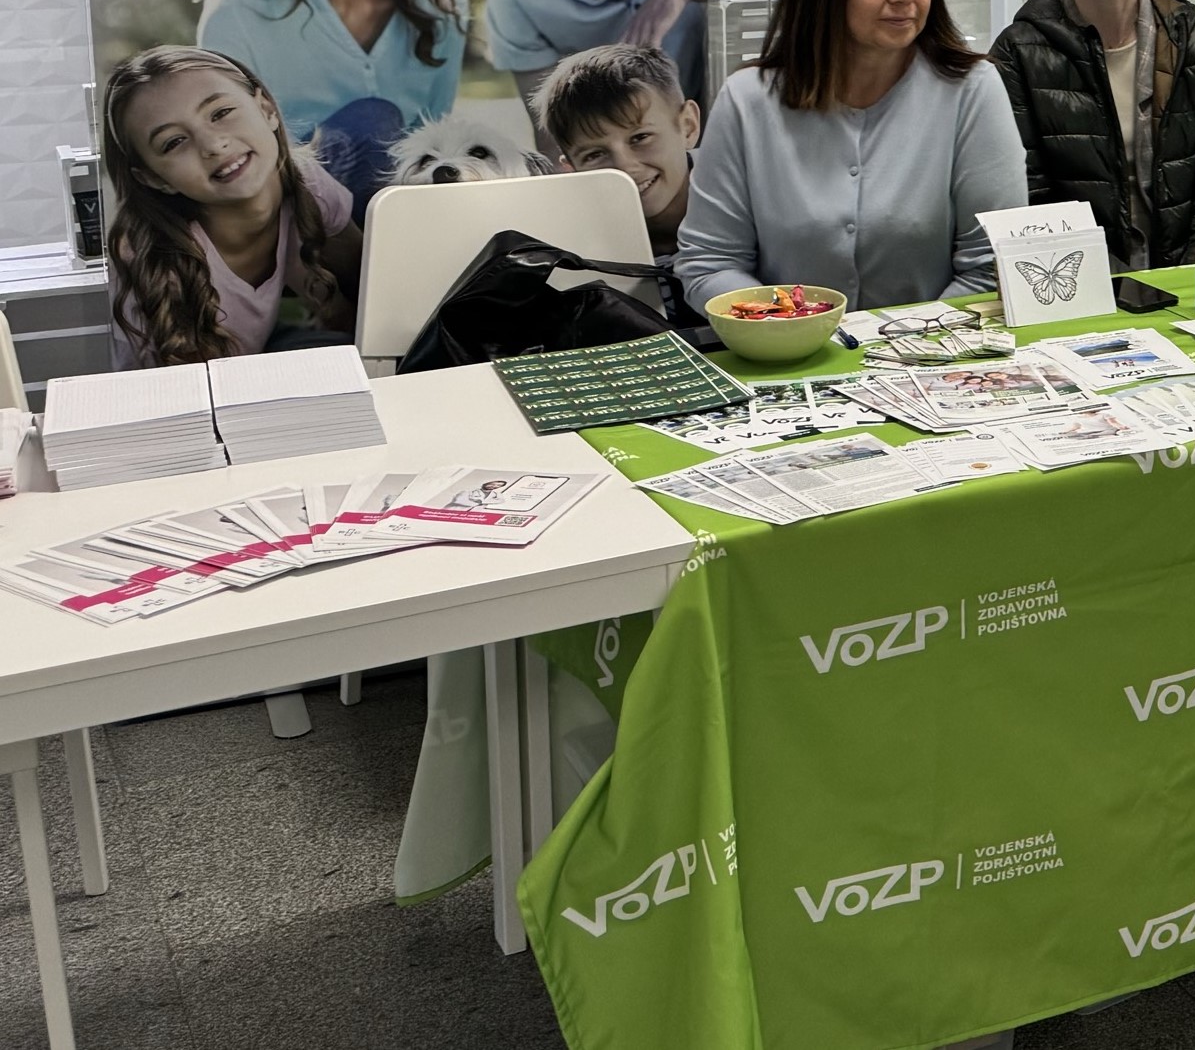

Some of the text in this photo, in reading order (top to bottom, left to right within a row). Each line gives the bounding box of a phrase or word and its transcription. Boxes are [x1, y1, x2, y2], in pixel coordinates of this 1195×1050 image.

[977, 577, 1056, 604] VOJENSKÁ
[978, 590, 1059, 620] ZDRAVOTNÍ
[978, 607, 1067, 636] POJIŠŤOVNA
[800, 605, 949, 674] VoZP
[974, 830, 1055, 858] VOJENSKÁ
[974, 842, 1057, 873] ZDRAVOTNÍ
[973, 857, 1064, 886] POJIŠŤOVNA
[560, 843, 697, 938] VoZP
[794, 860, 944, 923] VoZP
